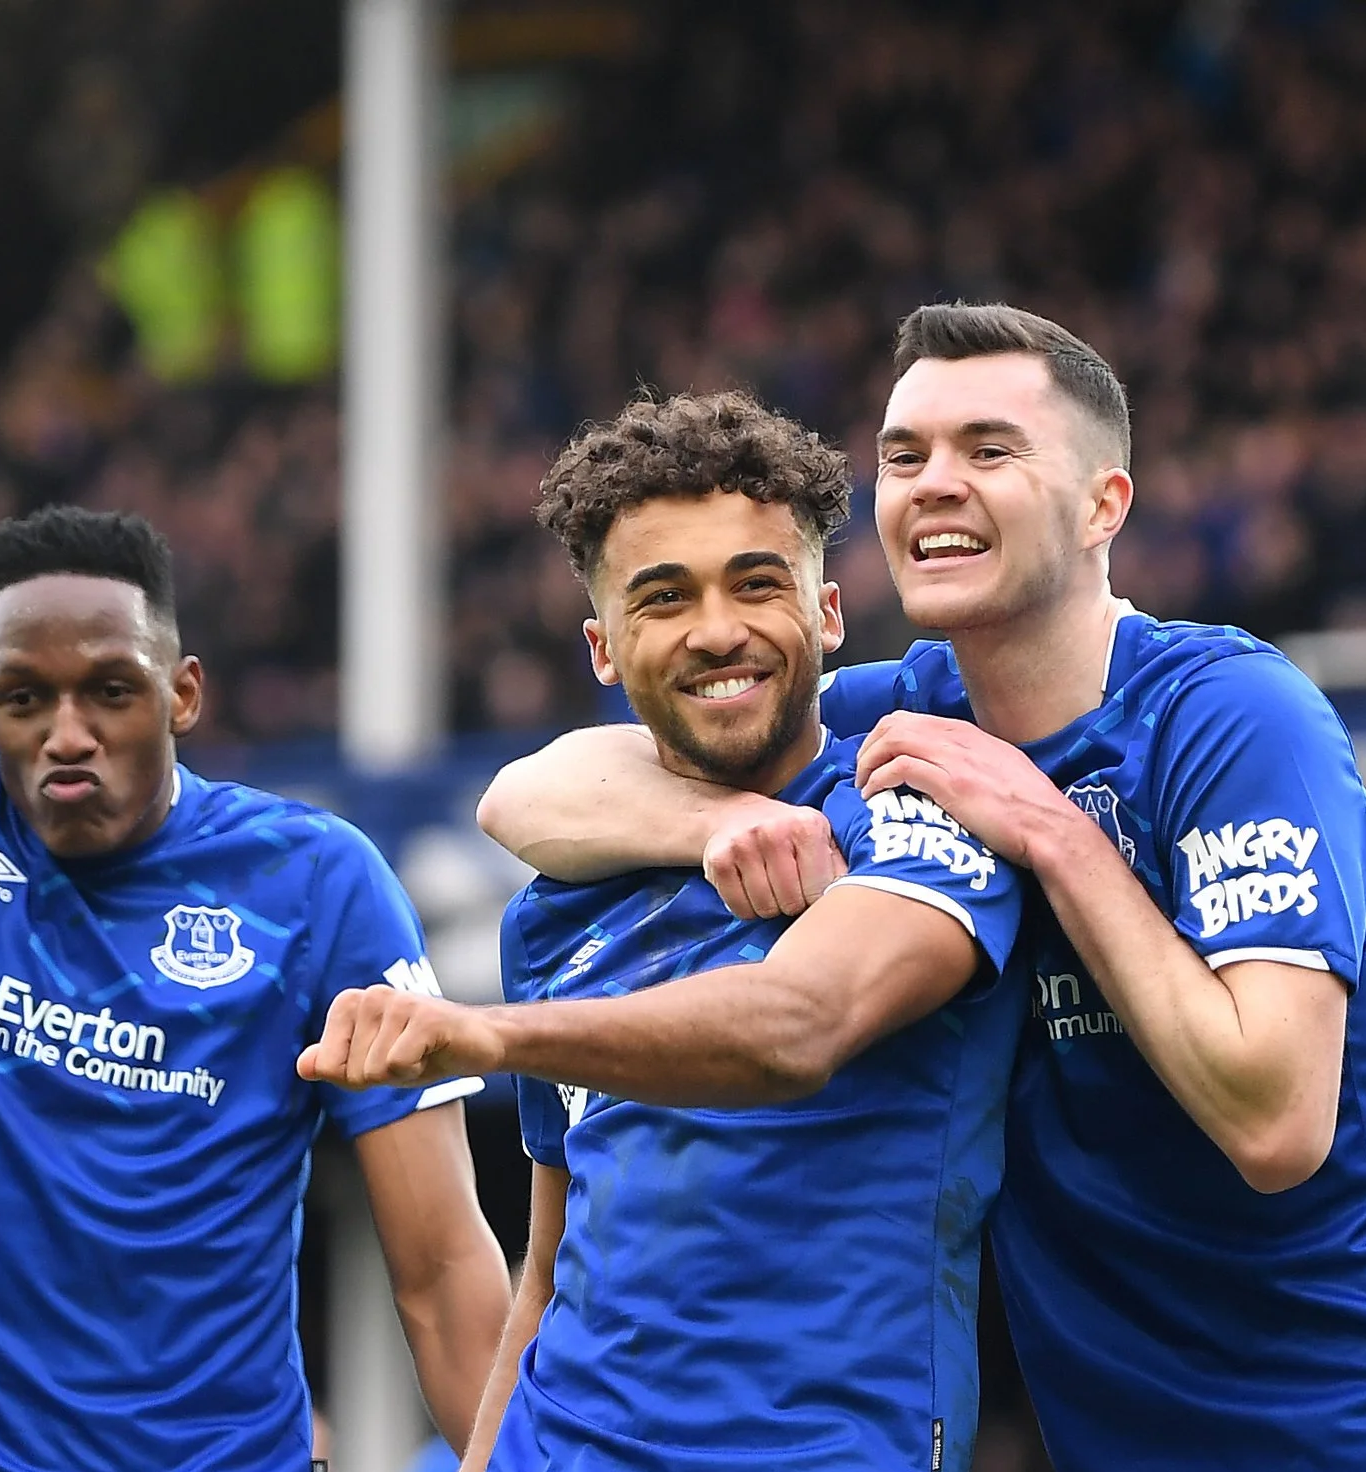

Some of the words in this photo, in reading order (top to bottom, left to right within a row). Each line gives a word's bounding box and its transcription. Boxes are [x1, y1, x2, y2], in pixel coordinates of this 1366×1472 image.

[868, 821, 996, 891] BIRDS
[1176, 818, 1319, 893] ANGRY
[1190, 868, 1319, 938] BIRDS
[15, 1027, 60, 1067] the
[65, 1047, 225, 1107] Community
